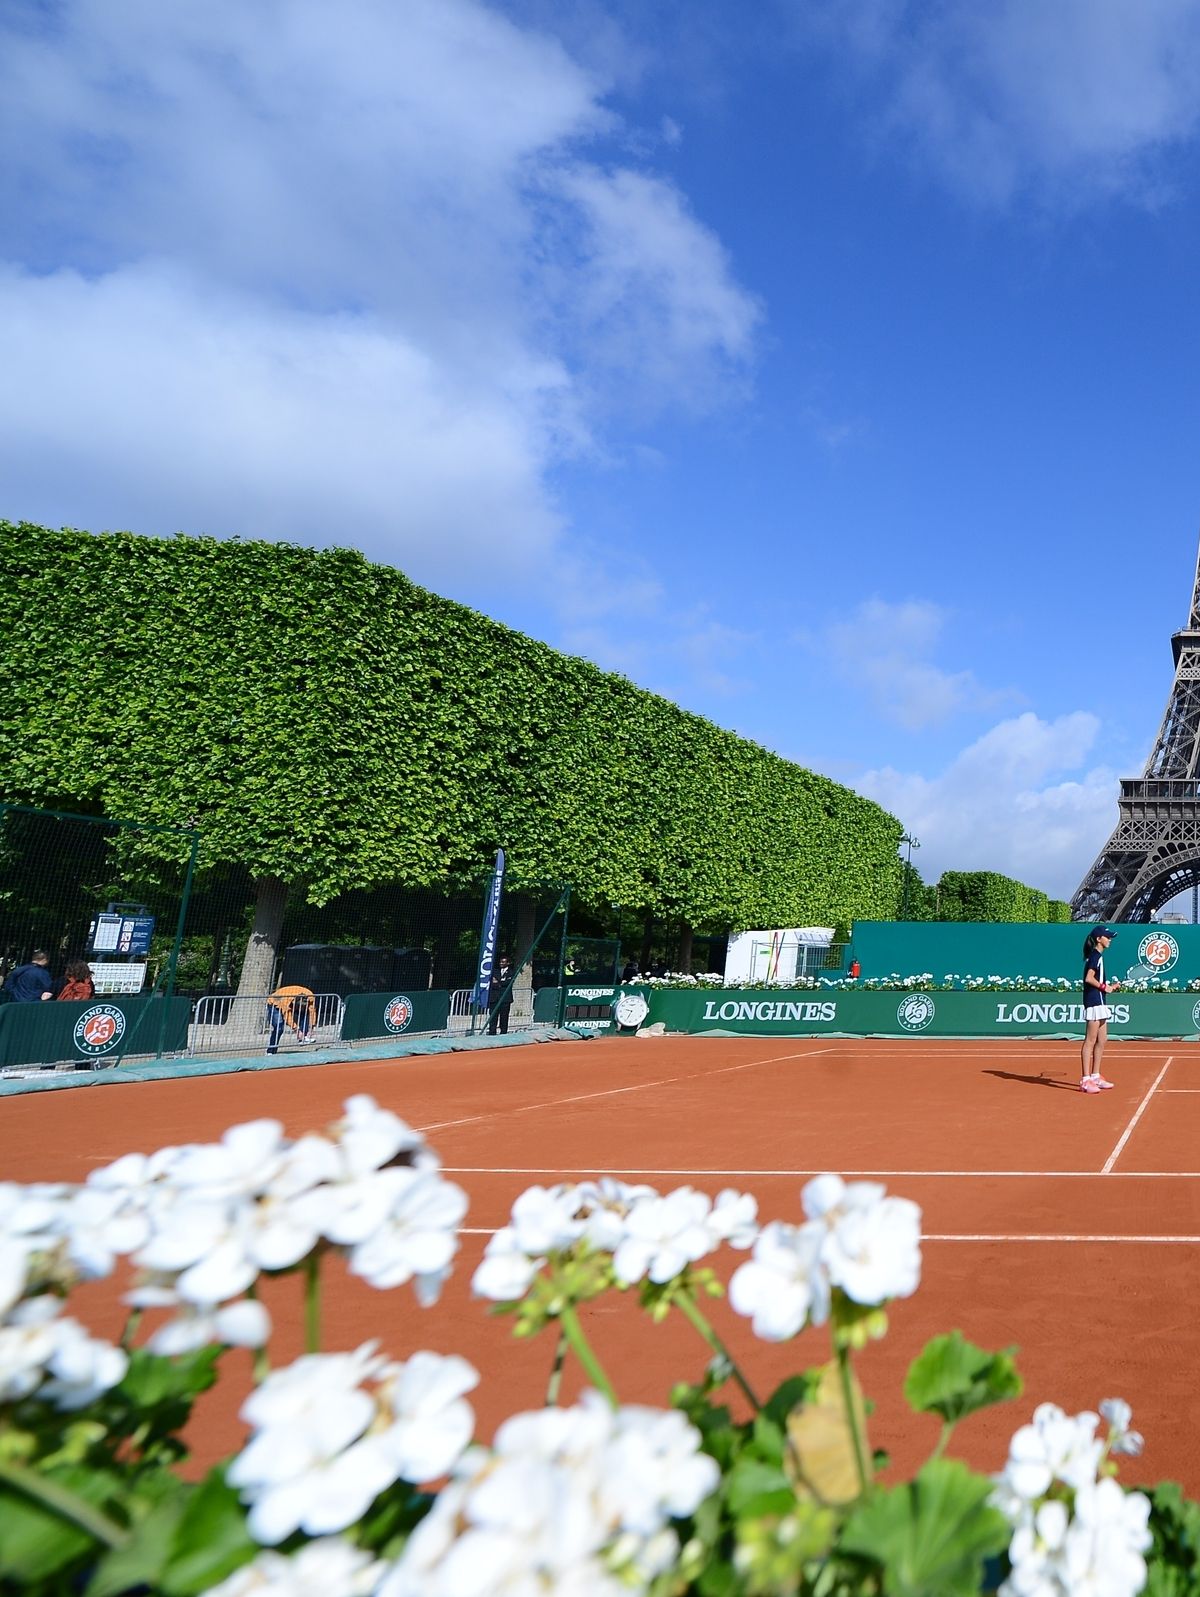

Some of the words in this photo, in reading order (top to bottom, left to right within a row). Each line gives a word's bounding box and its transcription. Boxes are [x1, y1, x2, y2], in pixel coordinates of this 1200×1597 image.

[1140, 934, 1159, 957] ROLAND
[1159, 934, 1177, 958] GARROS
[567, 988, 615, 997] LONGINES
[702, 1001, 837, 1022] LONGINES
[899, 995, 918, 1017] ROLAND
[918, 995, 933, 1017] GARROS
[76, 1007, 102, 1037] ROLAND
[104, 1007, 124, 1034] GARROS
[564, 1020, 612, 1029] LONGINES
